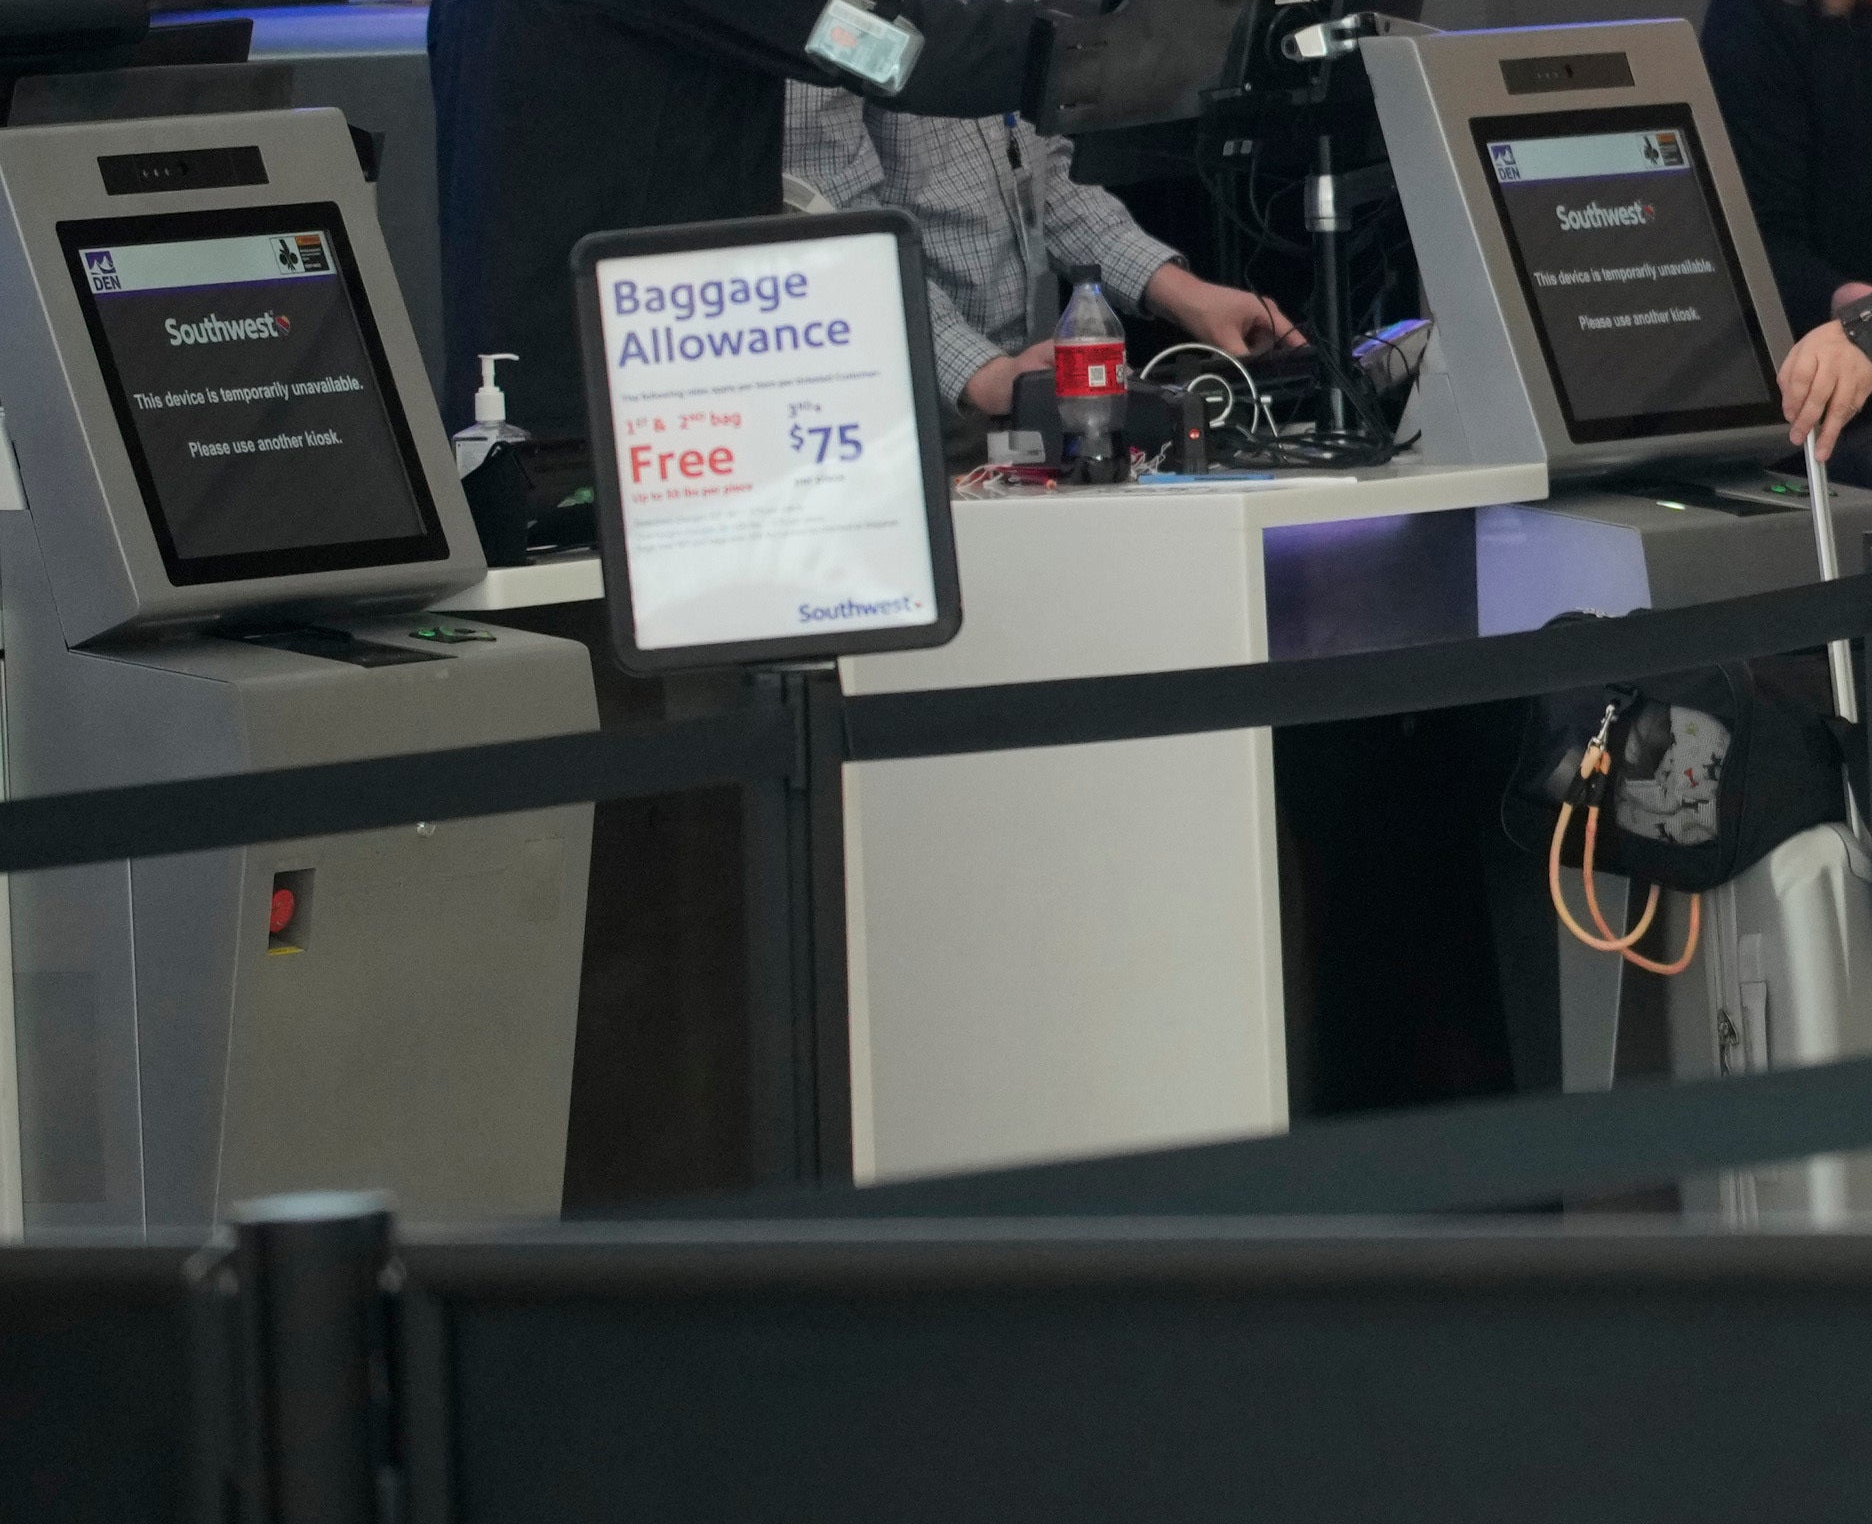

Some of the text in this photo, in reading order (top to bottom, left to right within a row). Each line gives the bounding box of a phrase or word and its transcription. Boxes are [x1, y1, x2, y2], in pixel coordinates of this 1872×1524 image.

[1499, 166, 1521, 181] DEN
[1556, 201, 1647, 231] Southwest
[94, 275, 121, 291] DEN
[1533, 259, 1715, 287] This device is temporarily unavailable.
[614, 272, 808, 321] Baggage
[164, 312, 279, 346] Southwest
[1578, 306, 1700, 331] Please use another kiosk.
[619, 319, 851, 368] Allowance
[134, 376, 364, 410] This device is temporarily unavailable.
[653, 418, 666, 433] &
[709, 411, 742, 429] bag
[188, 428, 343, 458] Please use another kiosk.
[789, 423, 863, 465] $75
[629, 444, 735, 484] Free
